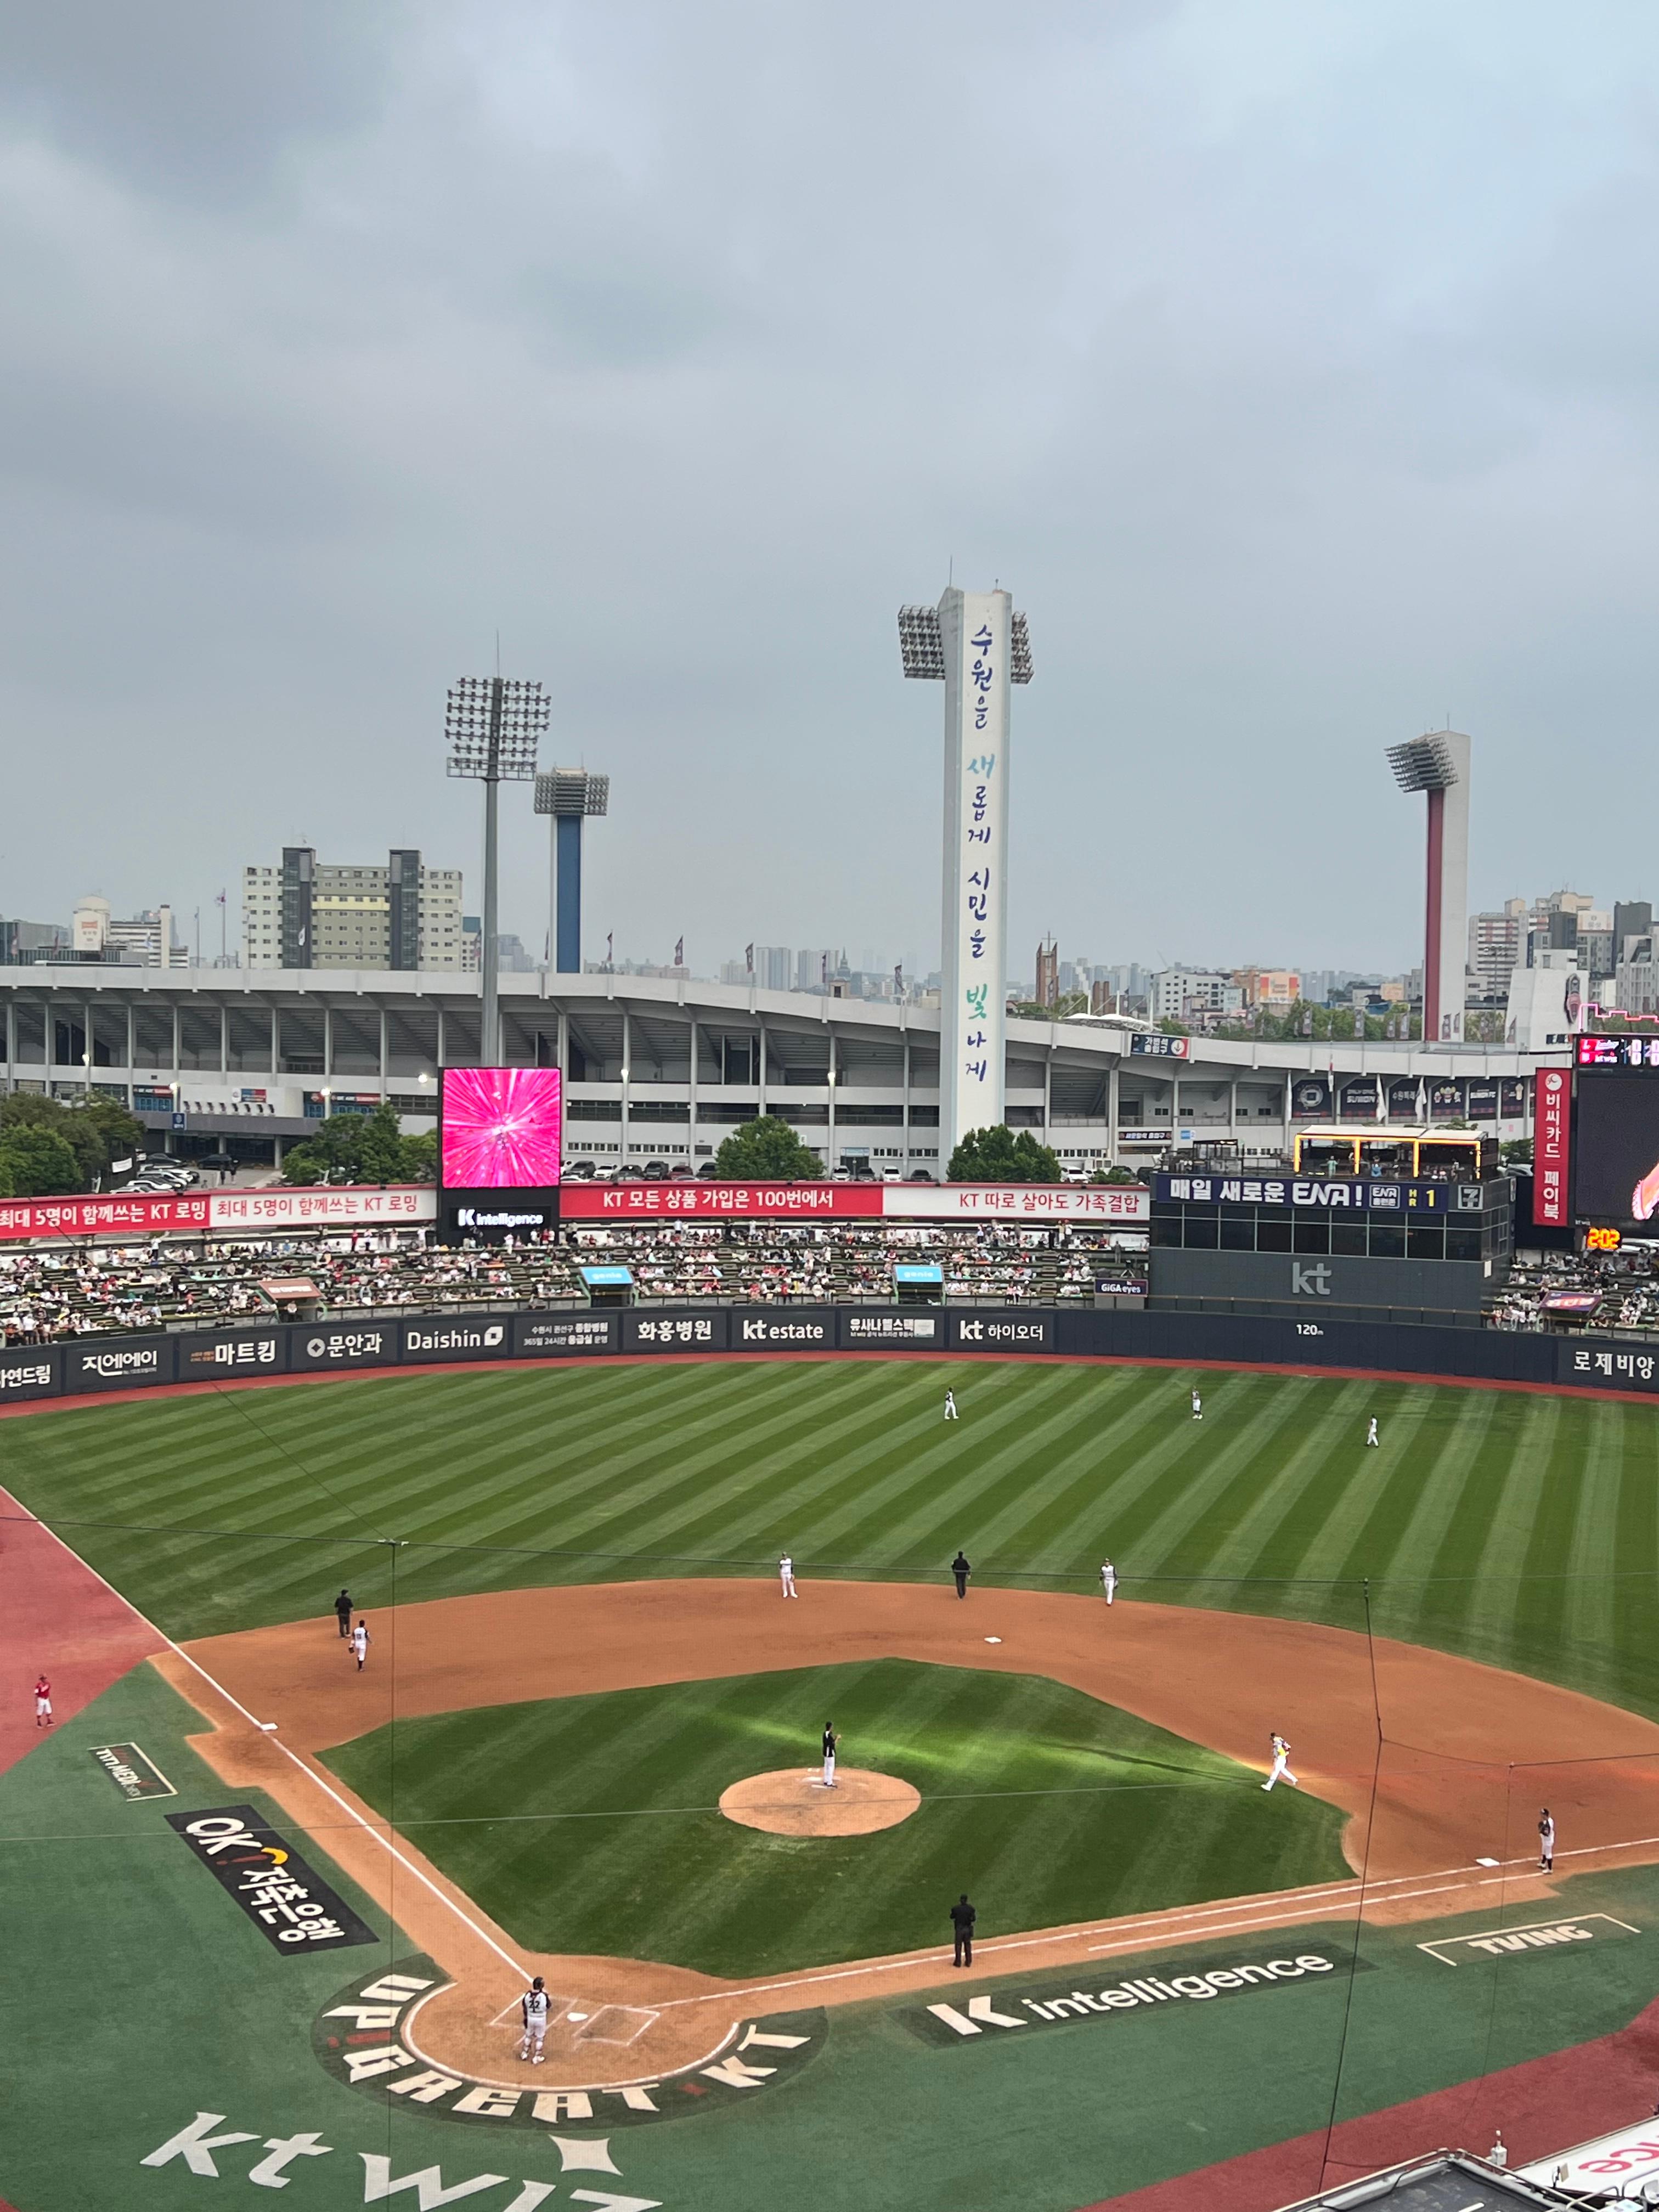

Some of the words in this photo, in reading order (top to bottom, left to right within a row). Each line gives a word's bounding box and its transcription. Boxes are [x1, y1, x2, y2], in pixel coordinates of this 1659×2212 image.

[969, 623, 994, 730] 수원을
[966, 753, 995, 845] 새롭게
[967, 867, 990, 959] 시민을
[965, 984, 988, 1082] 빛나게
[1545, 1093, 1561, 1158] 비씨카드
[603, 1191, 624, 1207] KT
[628, 1190, 661, 1209] 모든
[664, 1189, 698, 1209] 상품
[702, 1189, 750, 1209] 가입은
[756, 1189, 833, 1208] 100번에서
[959, 1193, 980, 1207] KT
[985, 1192, 1017, 1210] 따로
[1022, 1192, 1069, 1211] 살아도
[1075, 1193, 1139, 1214] 가족결합
[1170, 1179, 1211, 1200] 매일
[1219, 1181, 1285, 1203] 새로운
[1426, 1189, 1435, 1207] 1
[1543, 1171, 1559, 1220] 페이북
[0, 1209, 31, 1229] 최대
[35, 1205, 77, 1228] 5명이
[82, 1204, 145, 1226] 함께쓰는
[151, 1204, 172, 1220] KT
[175, 1200, 206, 1221] 로밍
[217, 1199, 247, 1217] 최대
[253, 1198, 292, 1217] 5명이
[298, 1197, 358, 1215] 함께쓰는
[364, 1197, 384, 1211] KT
[388, 1194, 417, 1212] 로밍
[458, 1209, 475, 1226] K
[477, 1213, 544, 1227] intelligence
[1293, 1262, 1332, 1295] kt
[407, 1329, 481, 1350] Daishin
[638, 1320, 712, 1342] 화홍병원
[743, 1319, 768, 1340] kt
[769, 1323, 823, 1339] estate
[960, 1320, 984, 1340] kt
[988, 1324, 1043, 1341] 하이오더
[215, 1340, 276, 1365] 마트킹
[328, 1333, 383, 1358] 문안과
[1574, 1351, 1655, 1379] 로제비앙
[238, 1867, 345, 1943] 저축은행
[1467, 1925, 1594, 1954] TVING
[927, 1995, 1028, 2036] K
[1023, 1955, 1334, 2021] intelligence
[342, 2044, 660, 2124] GREAT
[700, 2024, 811, 2089] KT
